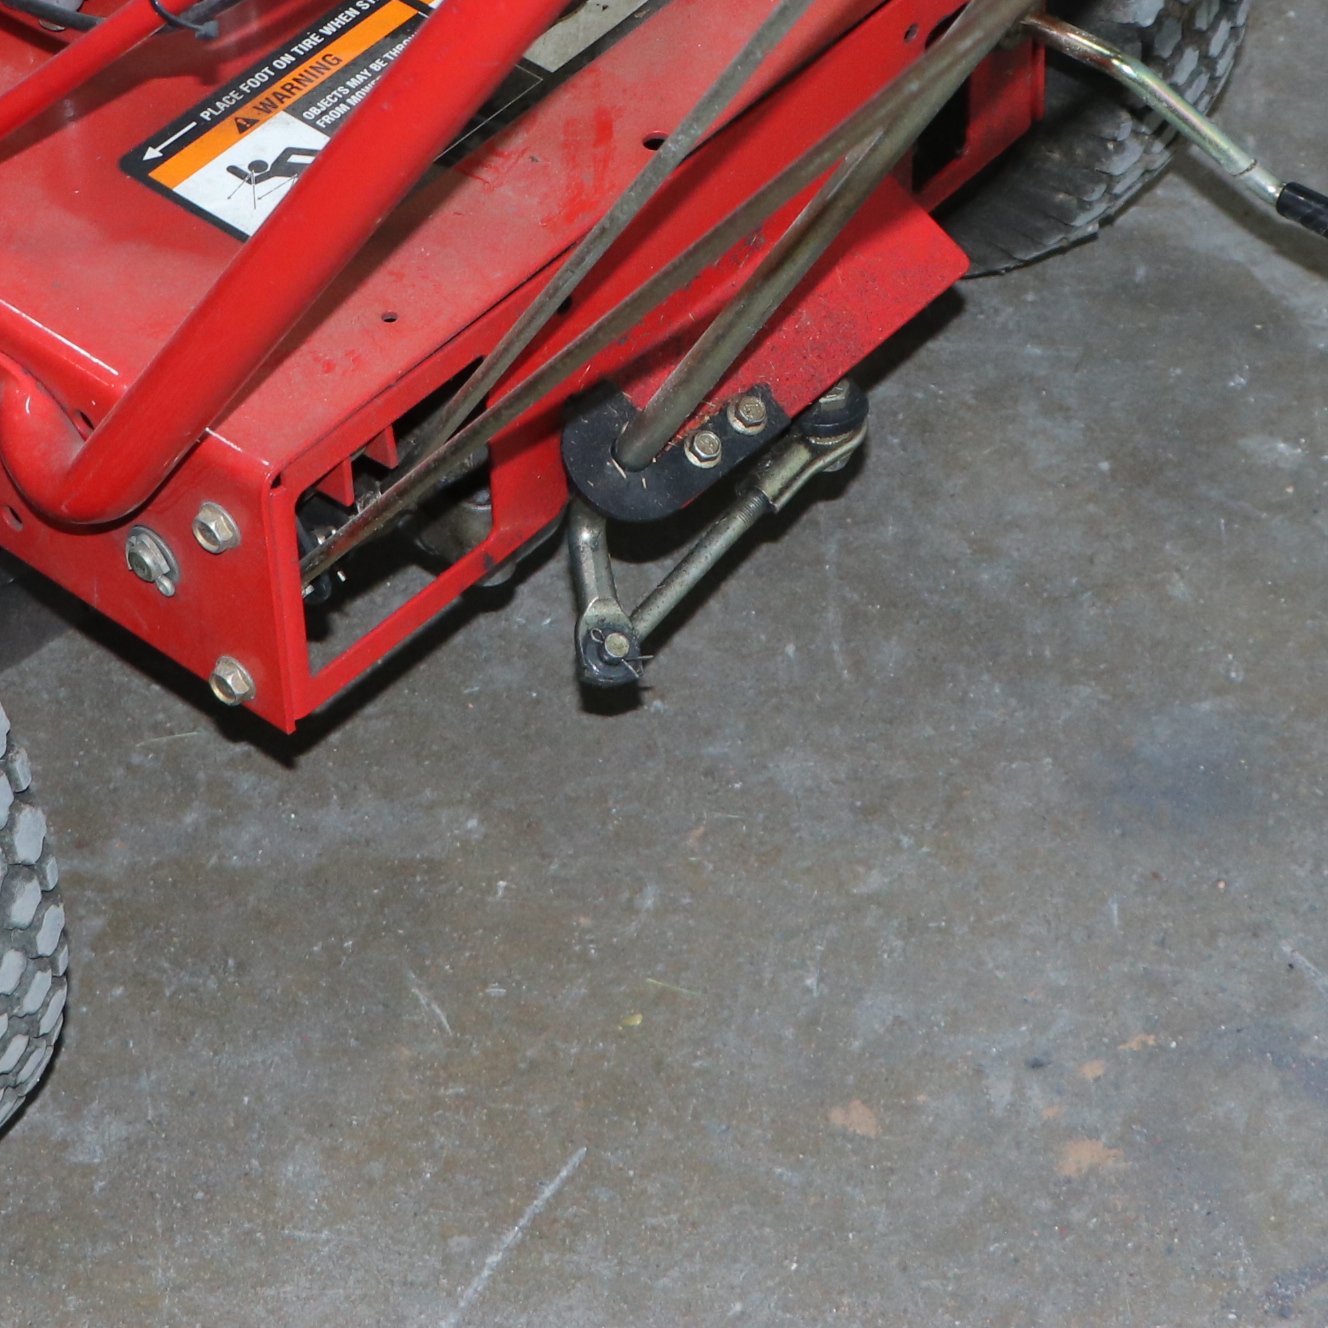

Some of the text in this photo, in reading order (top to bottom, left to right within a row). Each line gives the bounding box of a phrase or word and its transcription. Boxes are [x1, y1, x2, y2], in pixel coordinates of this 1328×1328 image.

[199, 88, 245, 121] PLACE
[238, 65, 277, 93] FOOT
[271, 51, 297, 70] ON
[290, 31, 326, 56] TIRE
[318, 6, 361, 36] WHEN
[252, 51, 343, 115] WARNING
[303, 58, 388, 120] OBJECTS MAY BE
[316, 103, 350, 128] FROM
